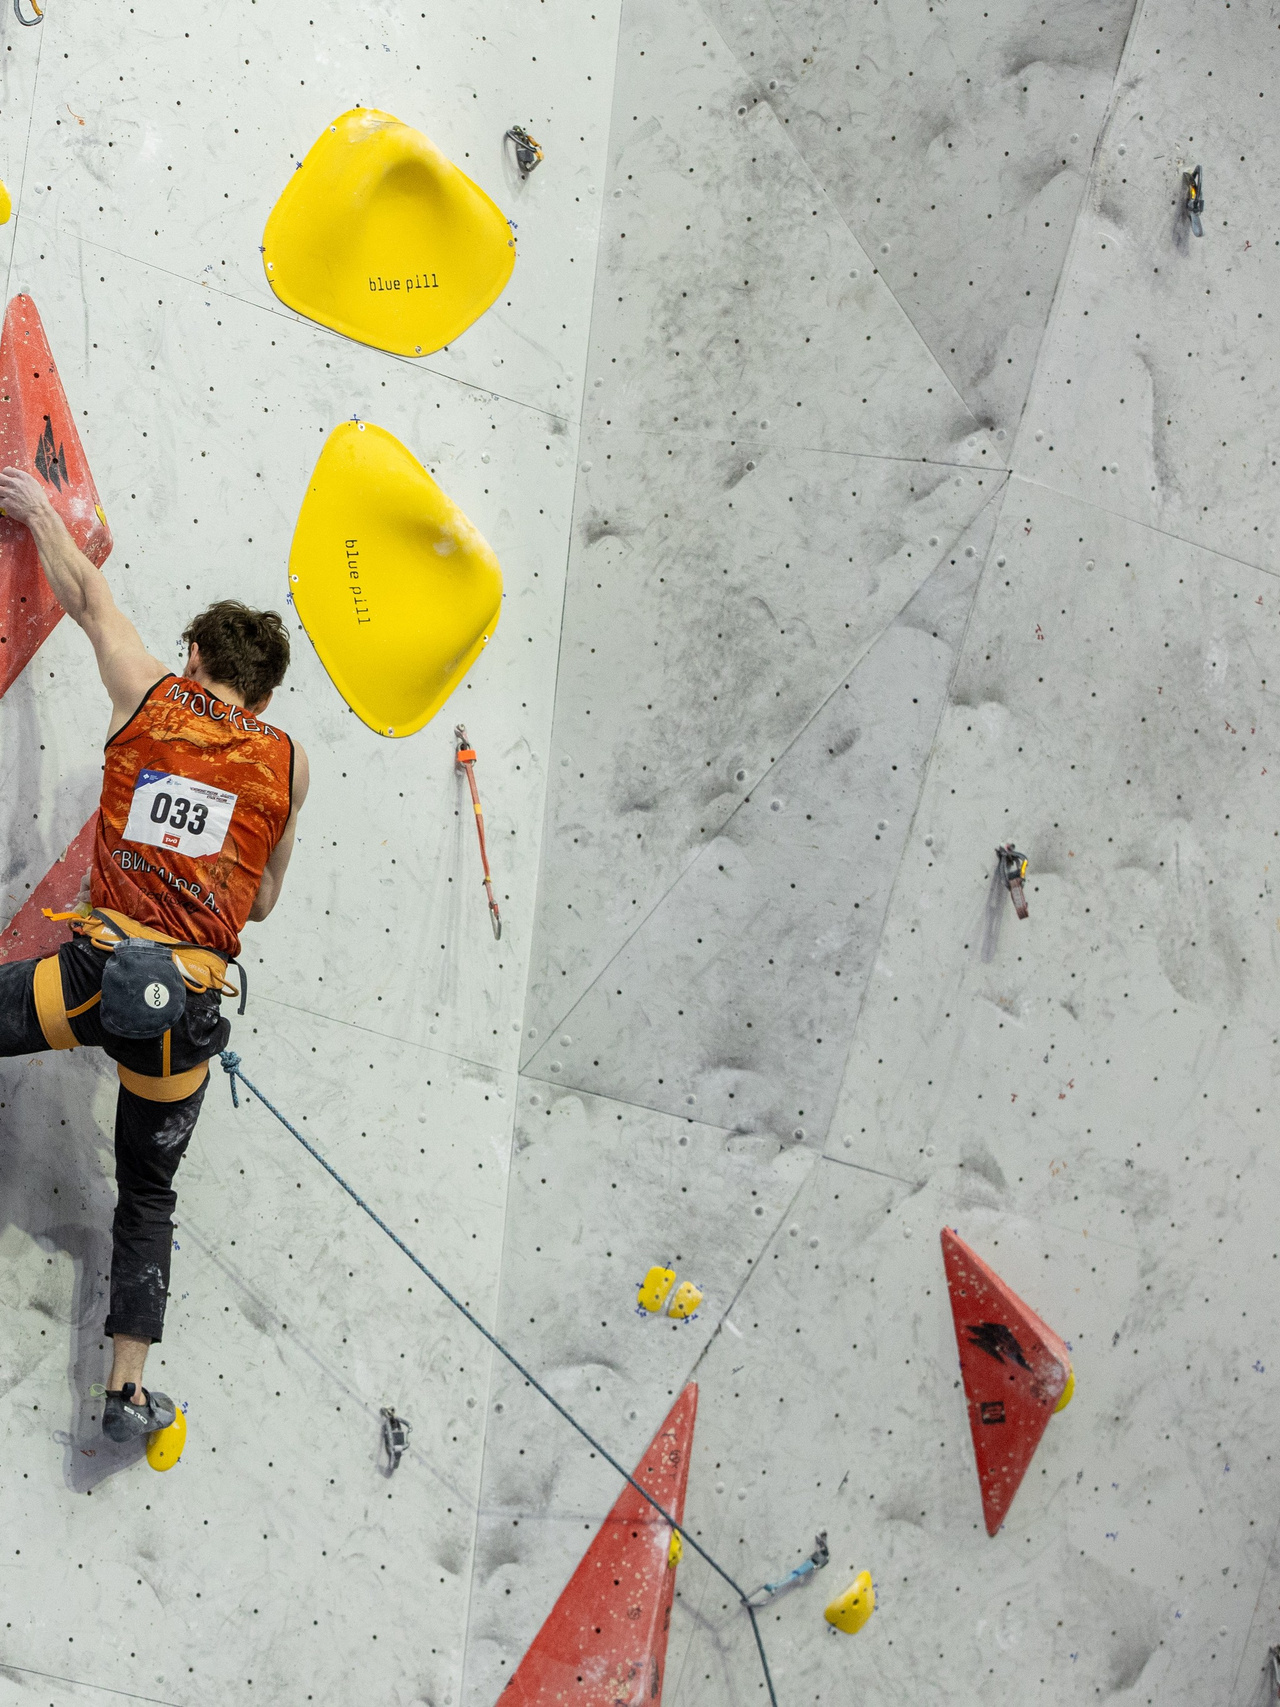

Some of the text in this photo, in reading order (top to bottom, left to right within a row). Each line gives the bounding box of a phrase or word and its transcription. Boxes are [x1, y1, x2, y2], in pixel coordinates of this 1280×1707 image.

[369, 273, 439, 292] blue pill
[345, 539, 371, 625] blue pill
[165, 683, 280, 741] МОСКВА
[150, 792, 209, 836] 033
